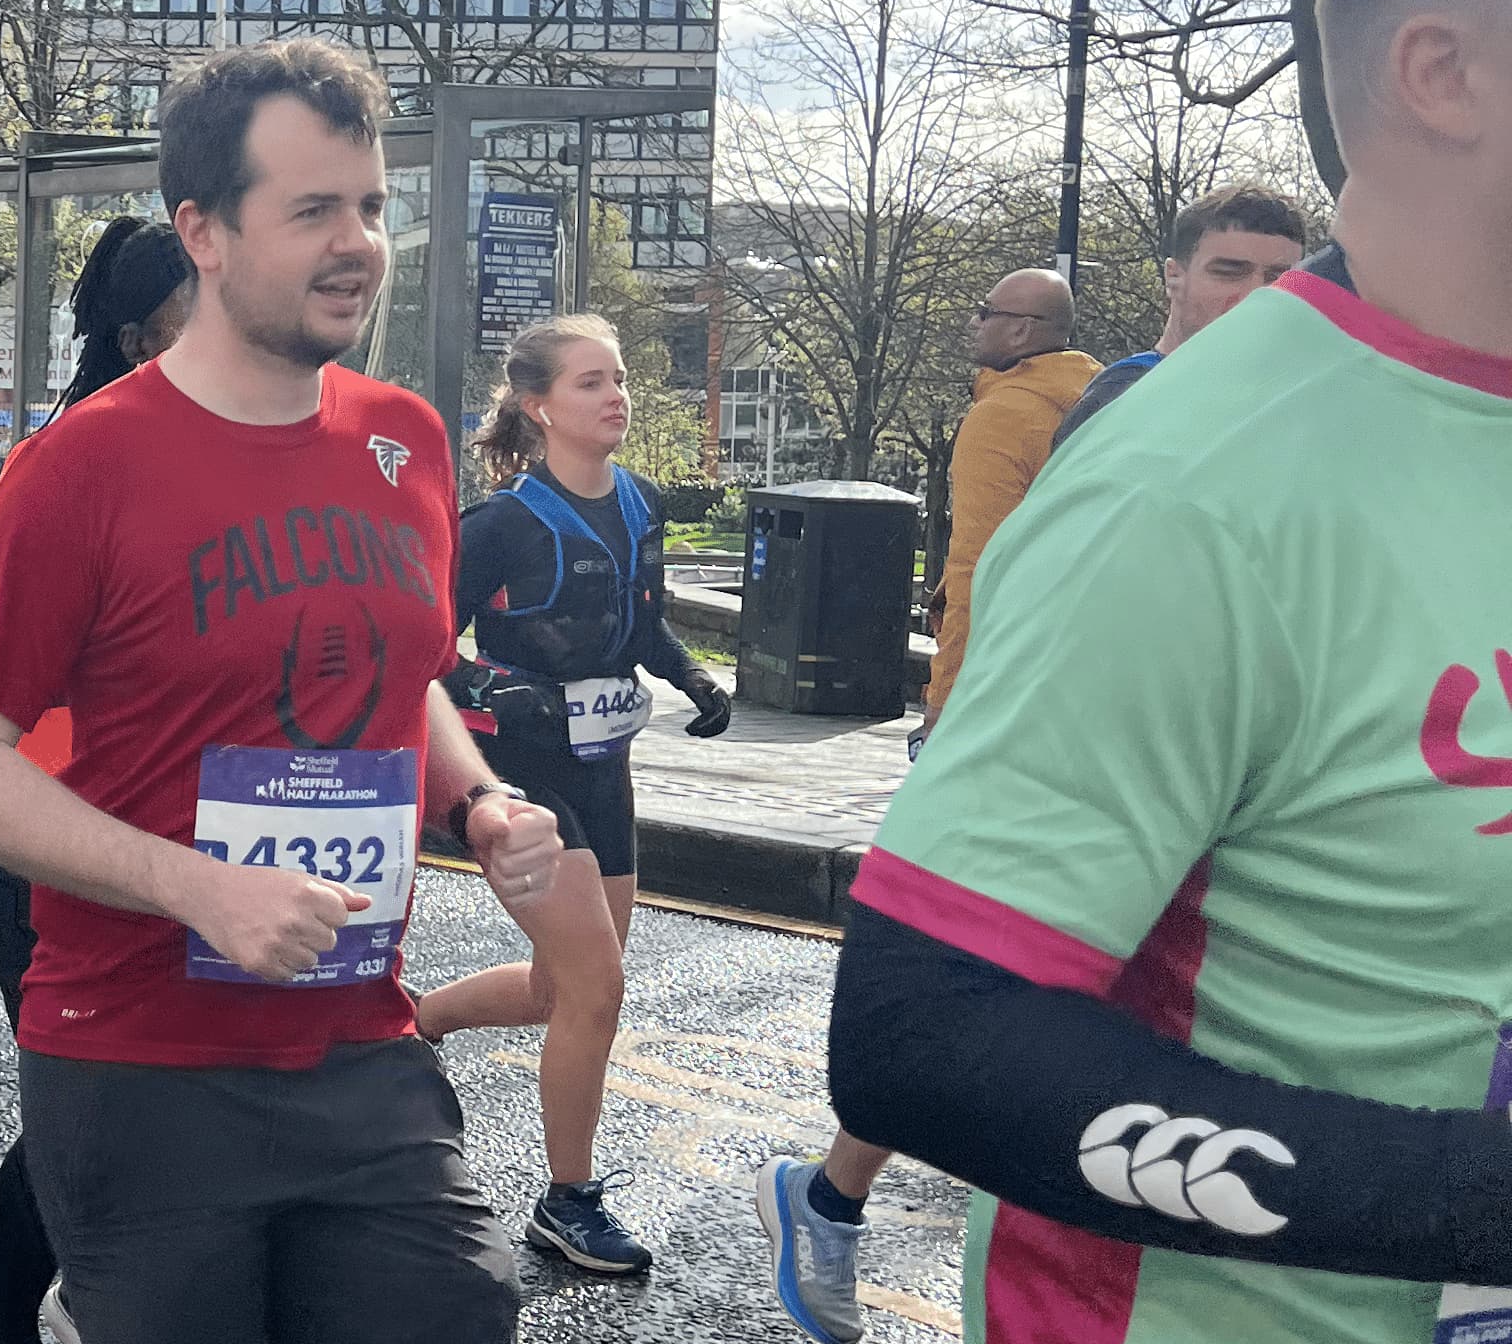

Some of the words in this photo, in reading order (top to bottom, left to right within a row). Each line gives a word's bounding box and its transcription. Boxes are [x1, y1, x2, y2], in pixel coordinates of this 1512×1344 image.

[489, 209, 552, 227] TEKKERS
[190, 504, 436, 637] FALCONS
[287, 777, 343, 789] SHEFFIELD
[287, 788, 315, 800] HALF
[318, 788, 378, 801] MARATHON
[240, 835, 386, 884] 4332
